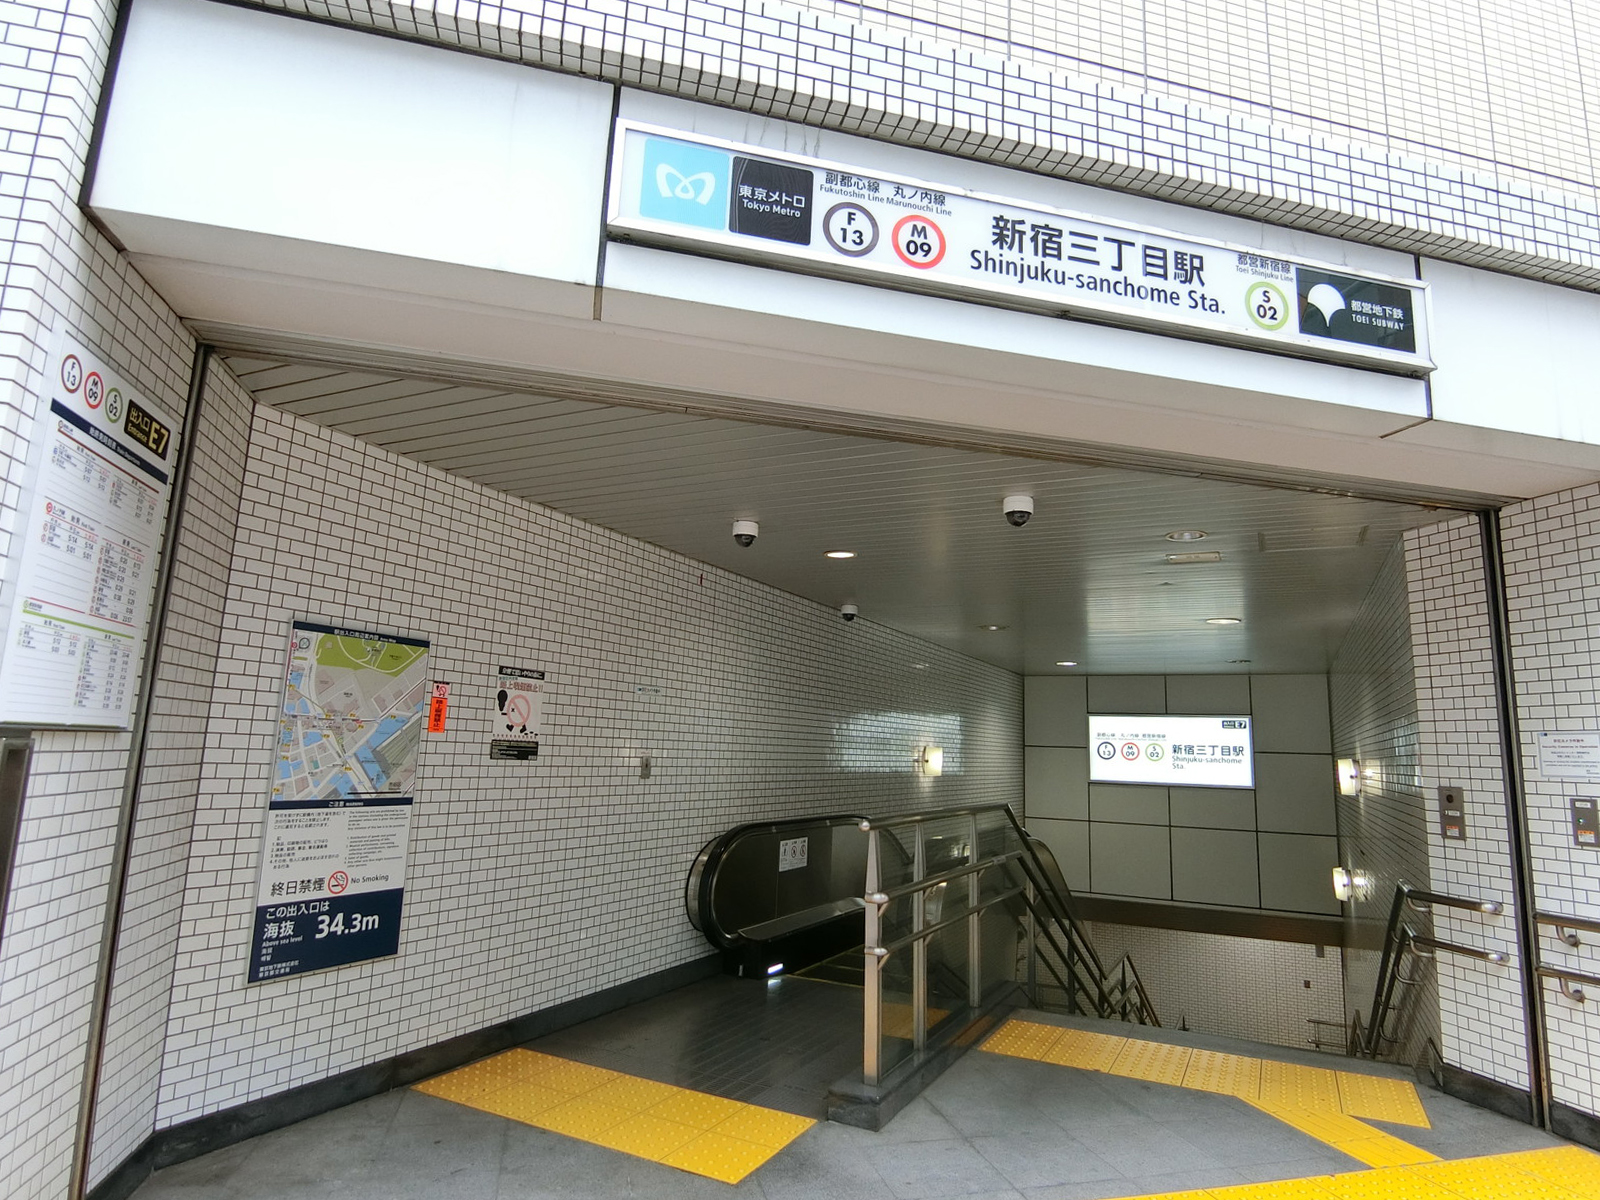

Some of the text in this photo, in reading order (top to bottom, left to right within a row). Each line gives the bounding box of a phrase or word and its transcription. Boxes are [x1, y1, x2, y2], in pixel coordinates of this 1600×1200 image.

[739, 184, 806, 208] 東京メトロ
[825, 172, 946, 206] 副都心線 丸ノ内線
[742, 199, 800, 218] Tokyo Metro
[820, 184, 952, 217] Fukutoshin Line Marunouchi Line
[847, 212, 856, 226] F
[840, 228, 864, 246] 13
[910, 224, 928, 240] M
[906, 240, 932, 258] 09
[992, 214, 1206, 288] 新宿三丁目駅
[1238, 254, 1292, 274] 都営新宿線
[970, 250, 1226, 314] Shinjuku-sanchome Sta.
[1236, 266, 1294, 282] Toei Shinjuku Line
[1262, 290, 1270, 304] S
[1256, 304, 1278, 321] 02
[1351, 300, 1404, 320] 都営地下鉄
[1352, 314, 1404, 330] TOEI SUBWAY
[71, 362, 76, 371] F
[67, 371, 77, 386] 13
[92, 378, 98, 387] M
[88, 388, 98, 401] 09
[113, 394, 118, 404] S
[109, 404, 118, 417] 02
[129, 407, 150, 432] 出入口
[128, 423, 148, 442] Entrance
[148, 421, 169, 454] E7
[1172, 744, 1244, 756] 新宿三丁目駅
[1172, 756, 1242, 764] Shinjuku-sanchome
[271, 877, 325, 897] 終日禁煙
[362, 874, 389, 883] Smoking
[266, 901, 330, 919] この出入口は
[263, 920, 296, 940] 海抜
[315, 912, 379, 939] 34.3m
